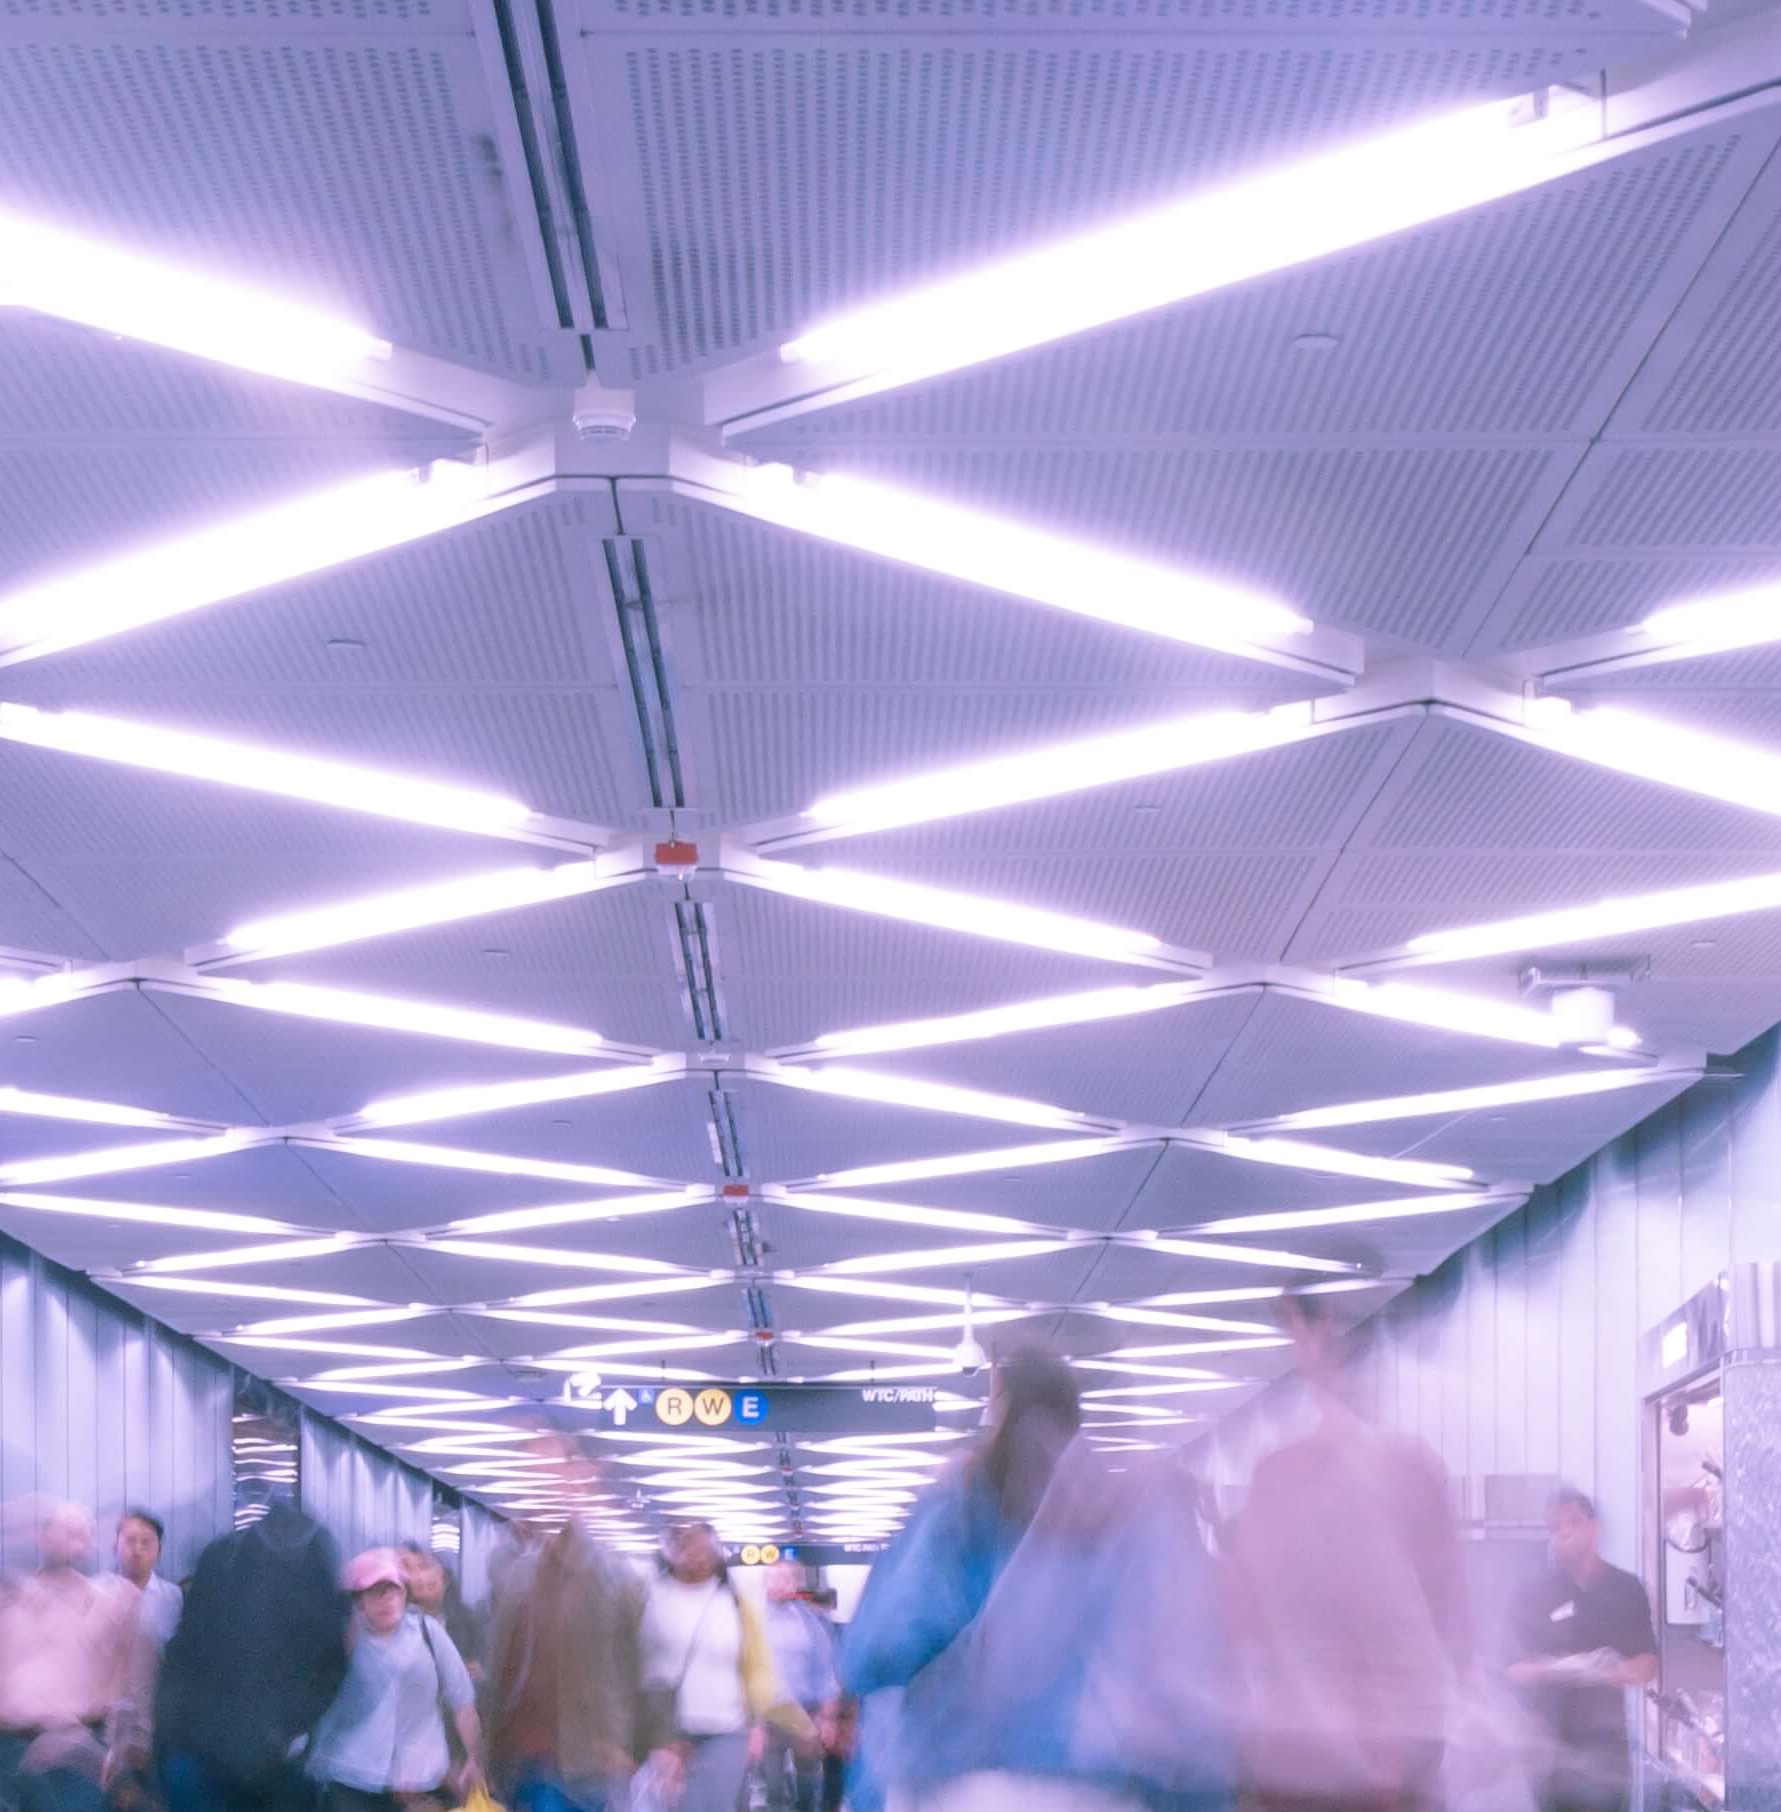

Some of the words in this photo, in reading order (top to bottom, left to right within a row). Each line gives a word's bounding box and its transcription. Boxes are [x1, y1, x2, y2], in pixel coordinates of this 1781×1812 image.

[862, 1389, 934, 1403] WTC/PATH
[667, 1397, 682, 1416] R
[702, 1397, 724, 1415] W
[742, 1396, 760, 1418] E
